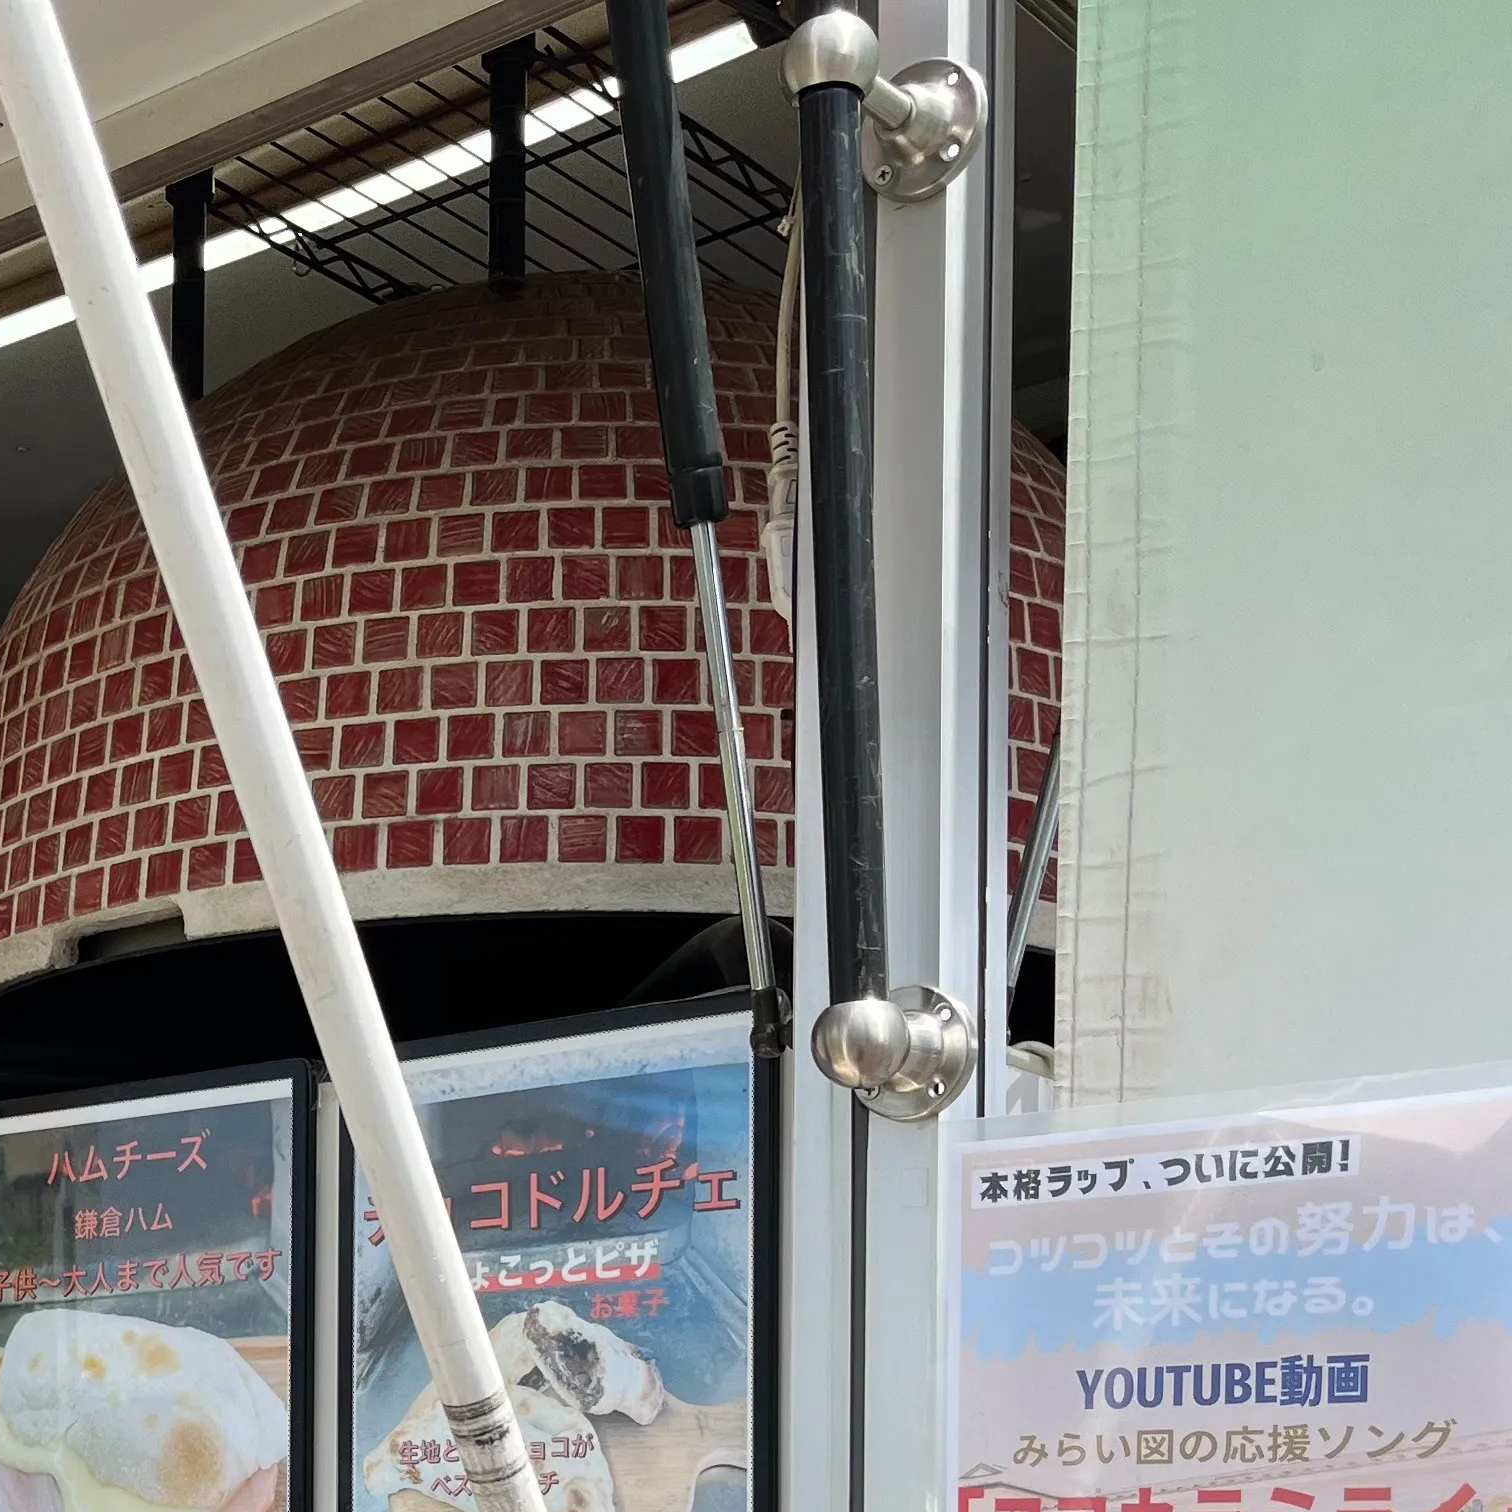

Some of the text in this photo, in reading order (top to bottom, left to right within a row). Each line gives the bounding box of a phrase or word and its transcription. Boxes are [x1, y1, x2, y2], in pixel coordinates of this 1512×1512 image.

[47, 1128, 212, 1186] ハムチーズ
[75, 1203, 173, 1241] 鎌倉ハム
[988, 1195, 1502, 1276] コツコツとその努力は、
[591, 1289, 668, 1318] お菓子
[1092, 1272, 1373, 1331] 未来になる。
[1077, 1354, 1371, 1410] YOUTUBE動画
[1013, 1417, 1457, 1467] みらい図の応援ソング
